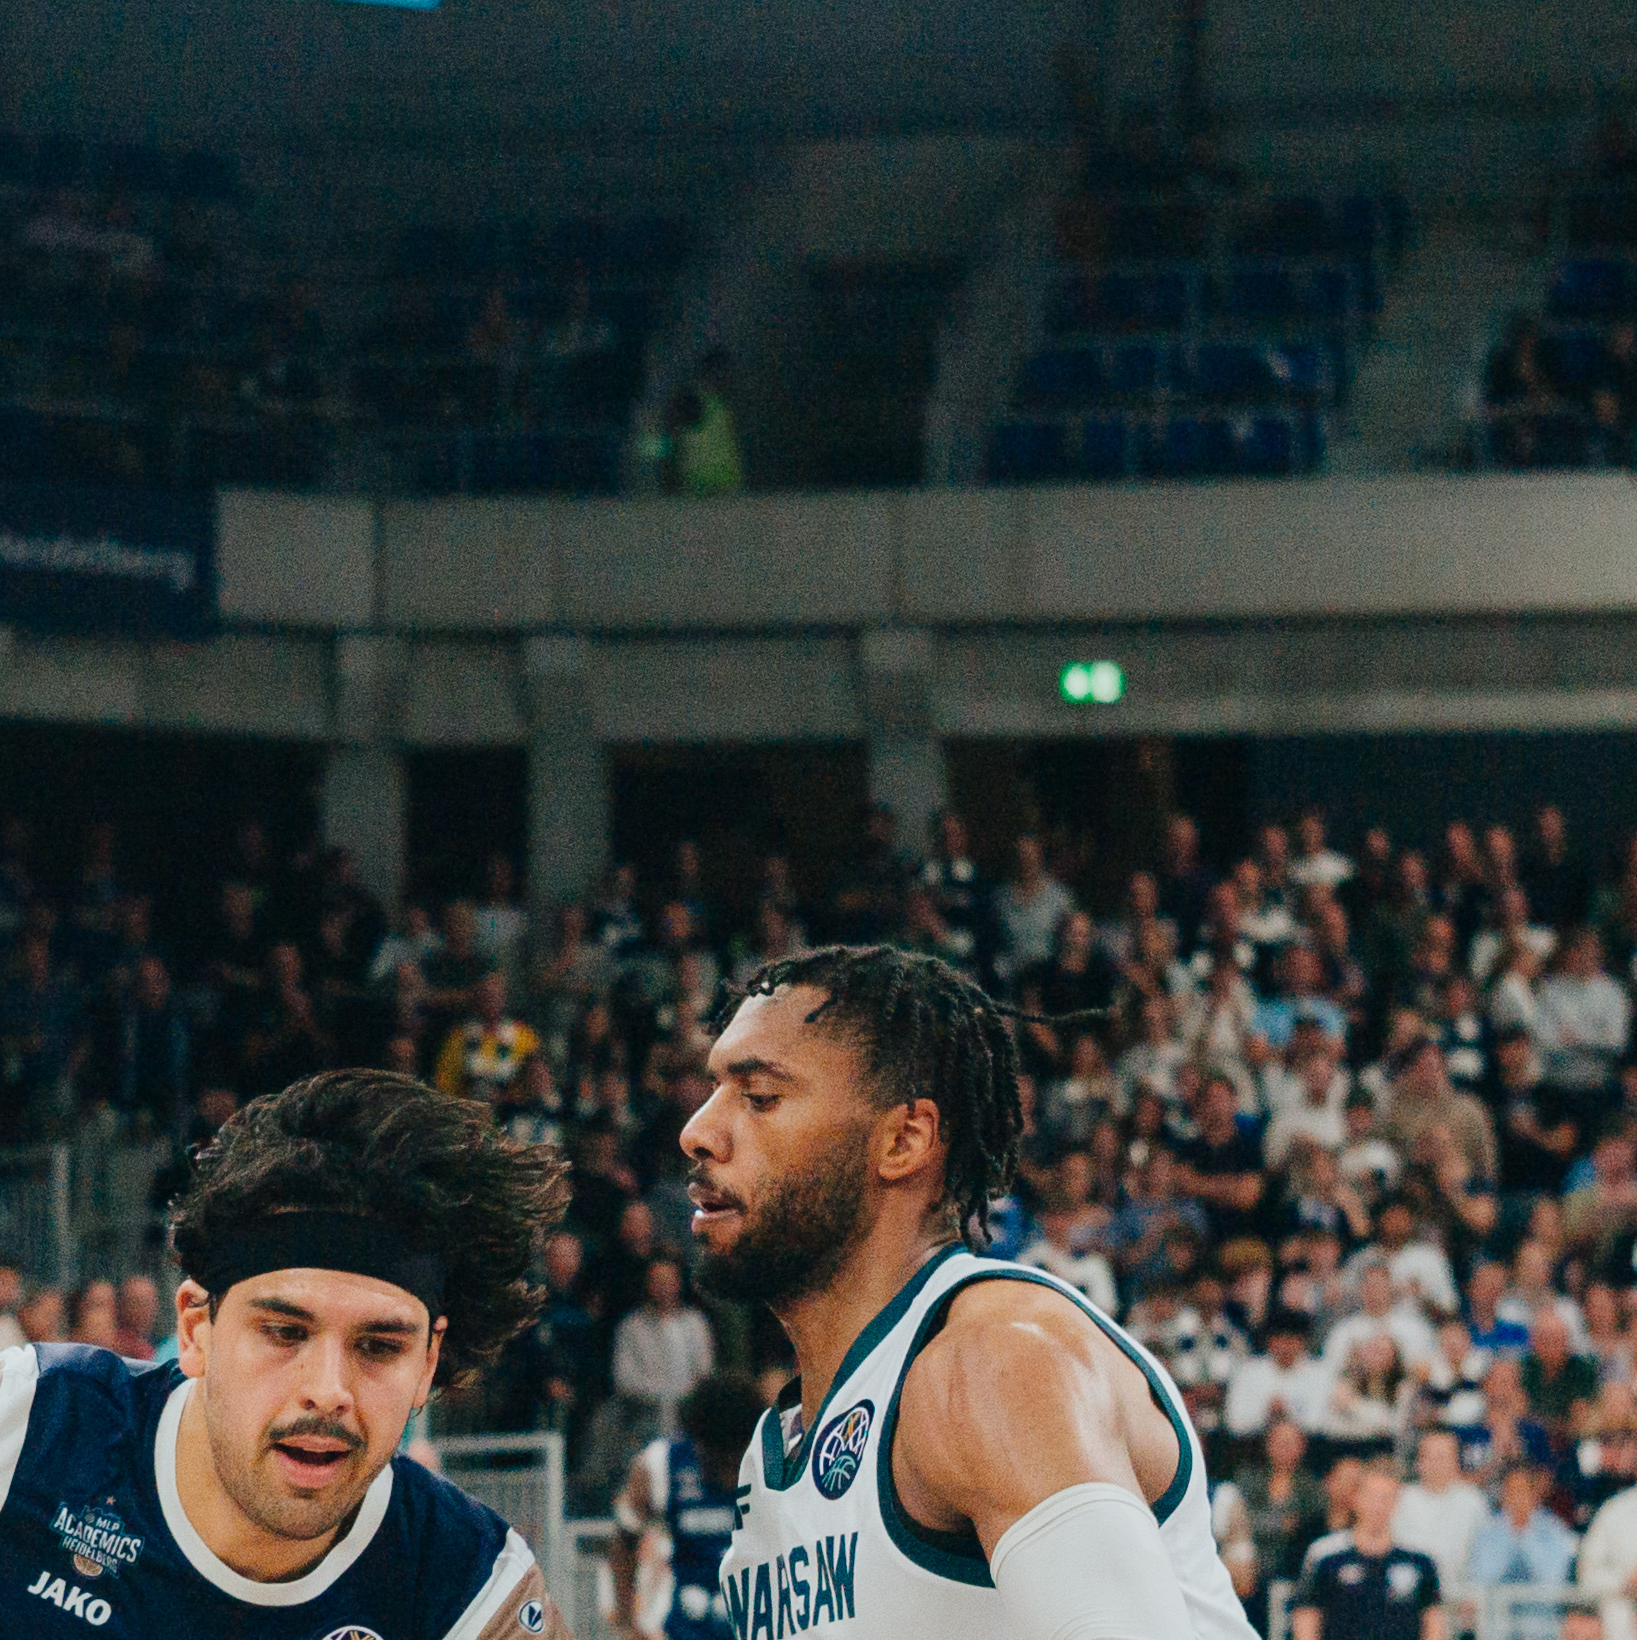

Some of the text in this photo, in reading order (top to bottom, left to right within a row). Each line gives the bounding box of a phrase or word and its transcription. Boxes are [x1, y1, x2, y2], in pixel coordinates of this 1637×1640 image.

[54, 1507, 142, 1563] ACADEMICS
[95, 1516, 120, 1531] MLP
[62, 1535, 119, 1575] HEIDELBERG
[27, 1571, 112, 1626] JAKO
